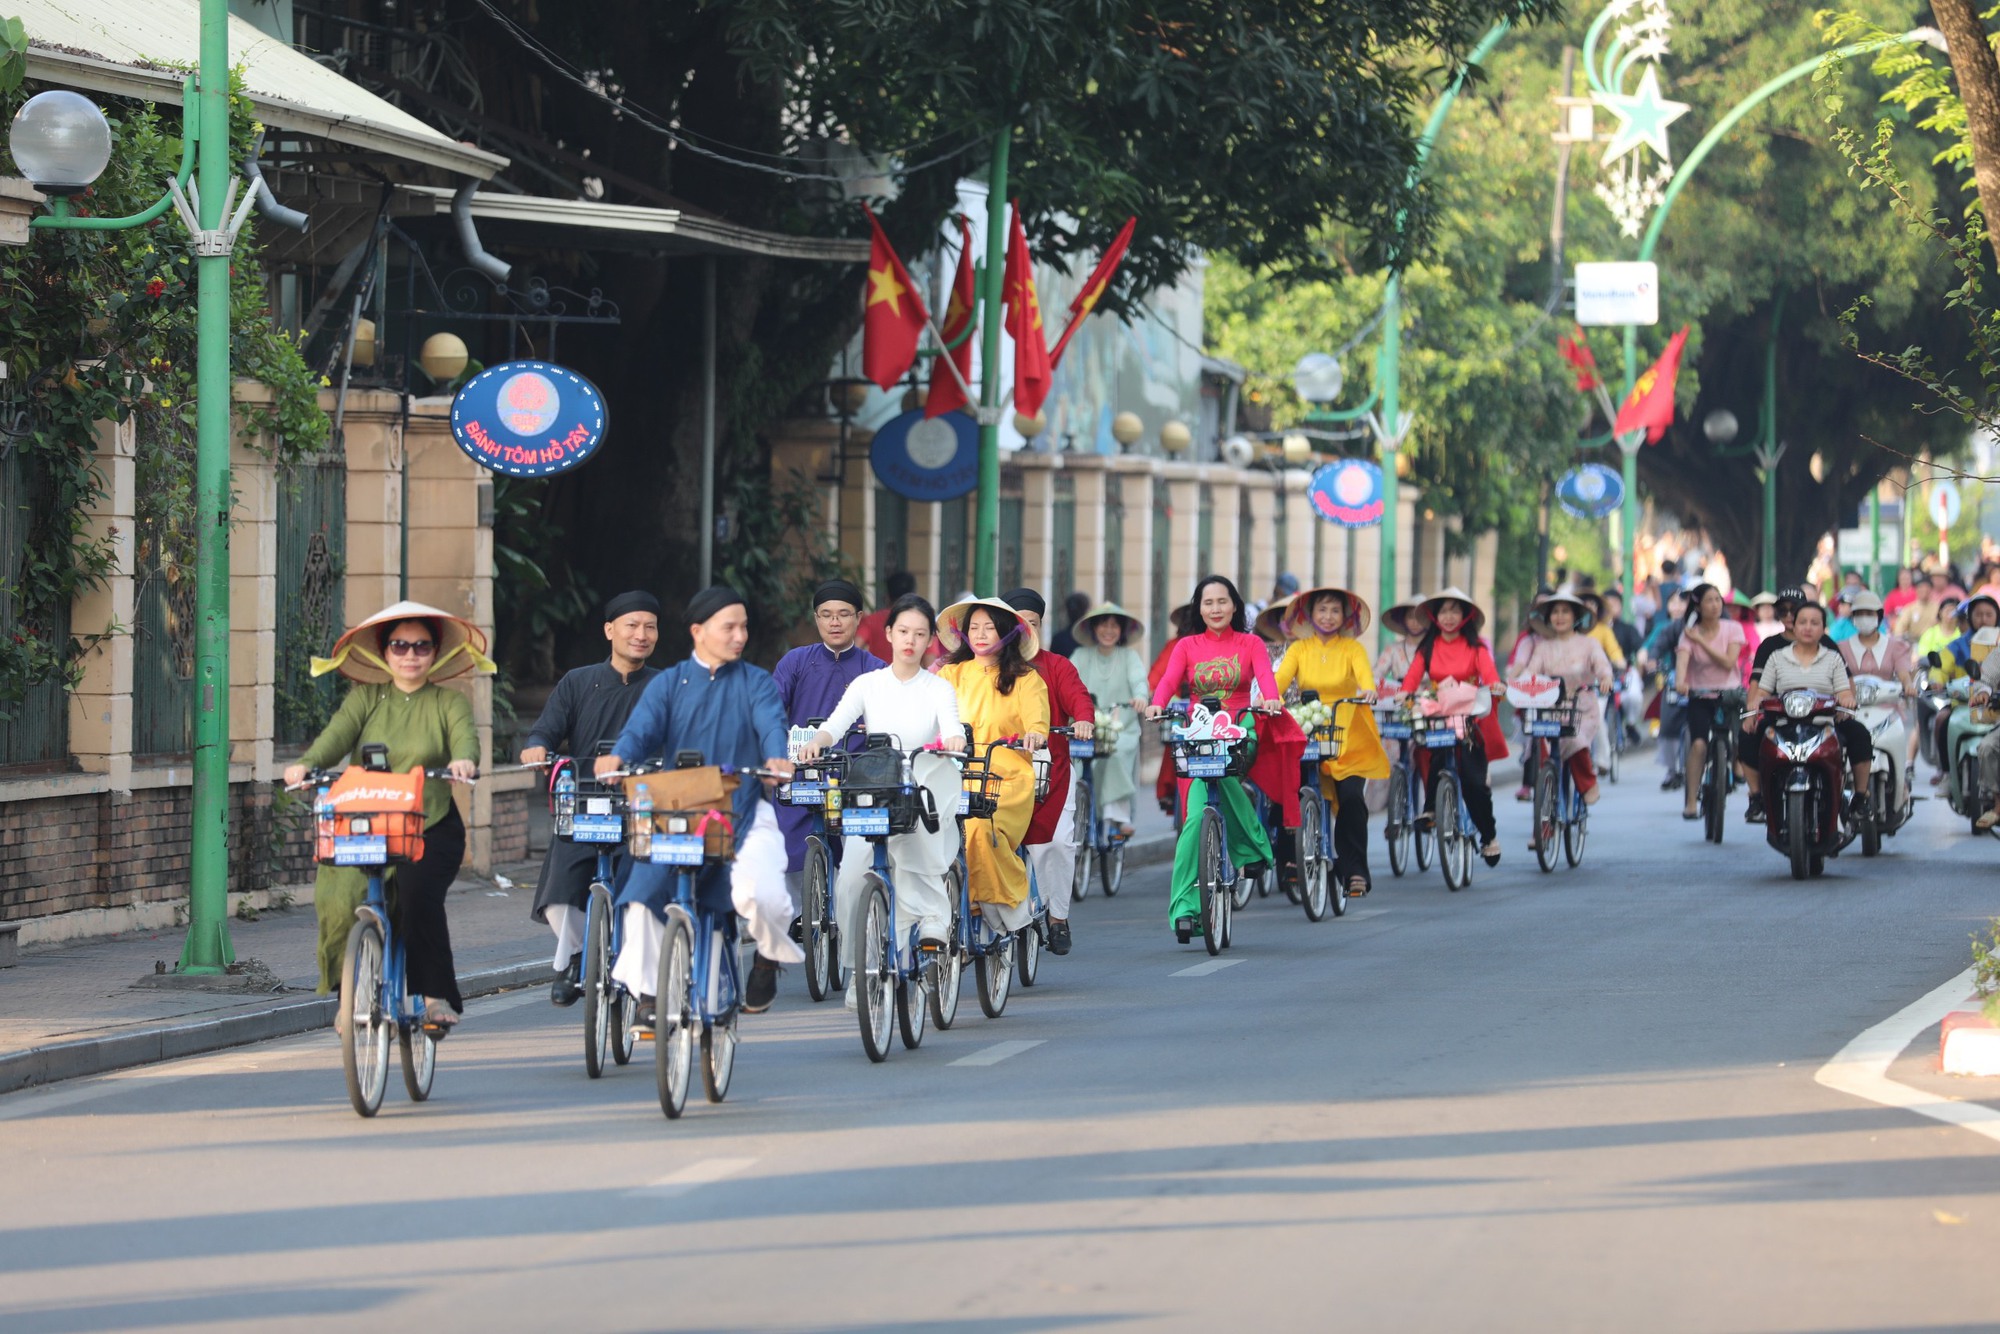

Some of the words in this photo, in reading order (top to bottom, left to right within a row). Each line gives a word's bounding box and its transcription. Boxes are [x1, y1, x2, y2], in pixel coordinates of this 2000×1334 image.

[465, 420, 502, 457] BÁNH
[503, 445, 538, 464] TÔM
[540, 439, 565, 464] HỒ
[562, 423, 591, 453] TÂY
